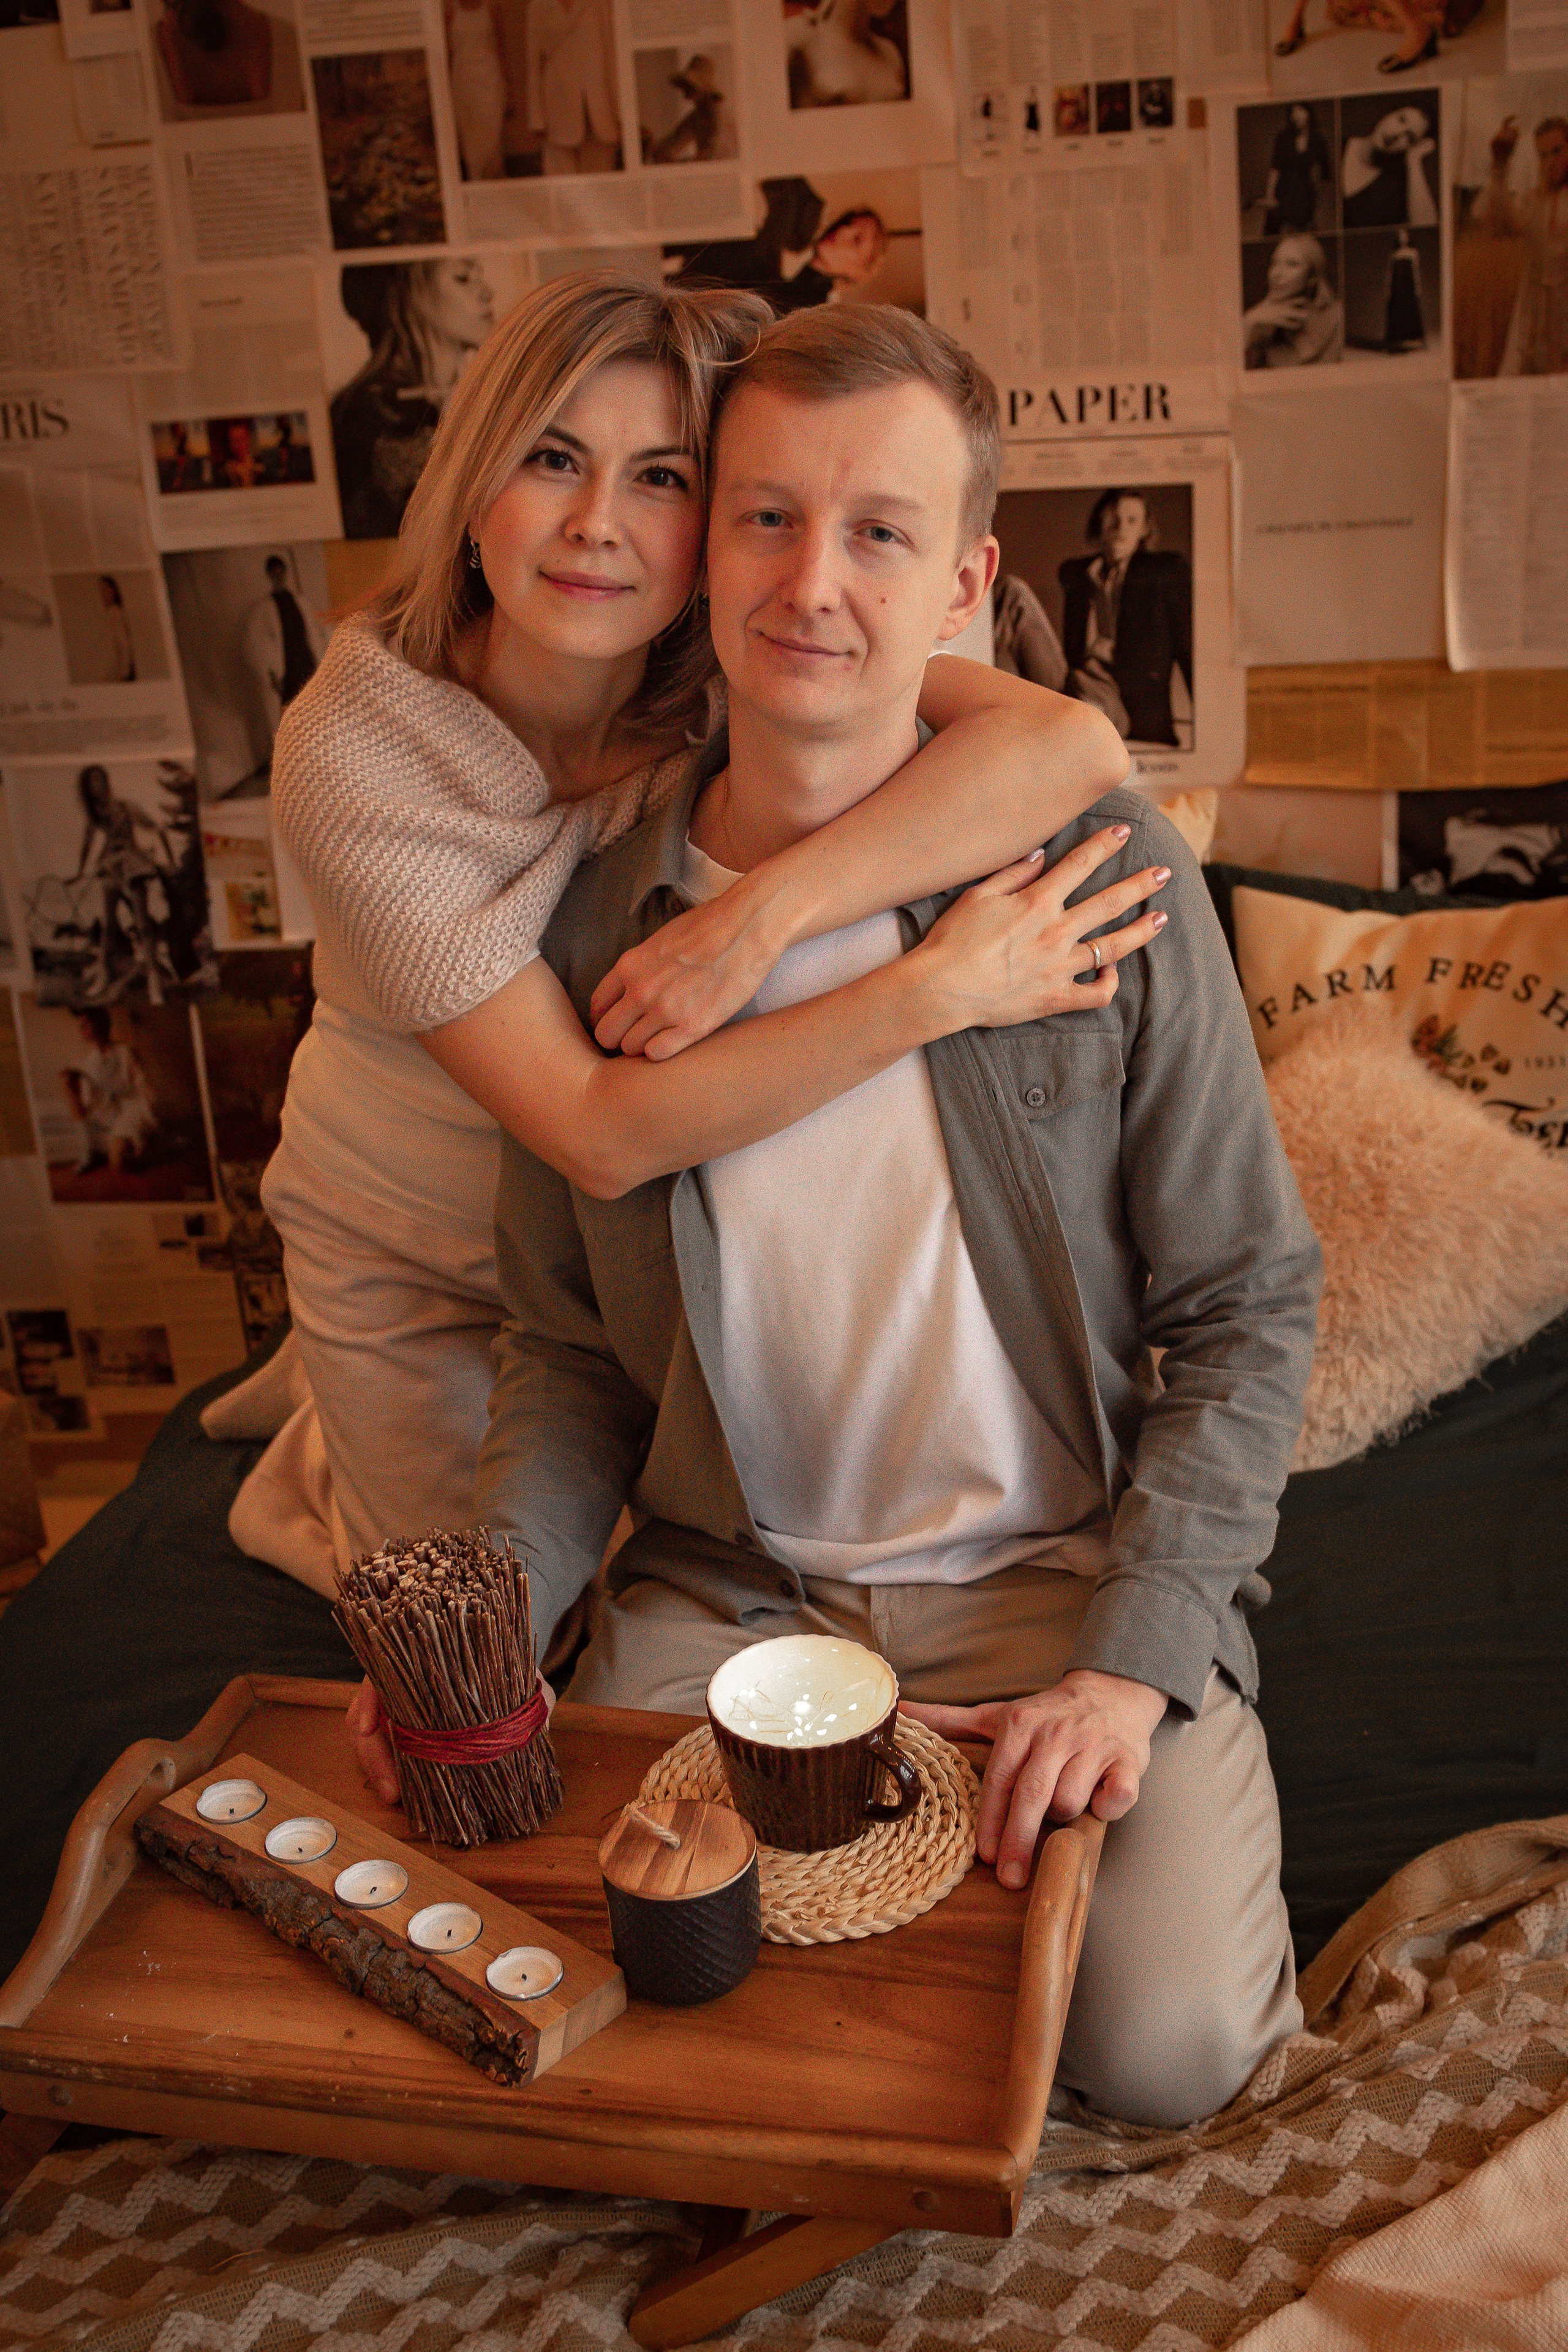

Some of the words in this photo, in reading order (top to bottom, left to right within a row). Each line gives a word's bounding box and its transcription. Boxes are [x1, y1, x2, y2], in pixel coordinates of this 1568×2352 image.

[1008, 382, 1172, 427] PAPER
[1257, 965, 1397, 1030] FARM
[1424, 957, 1568, 1031] FRESH
